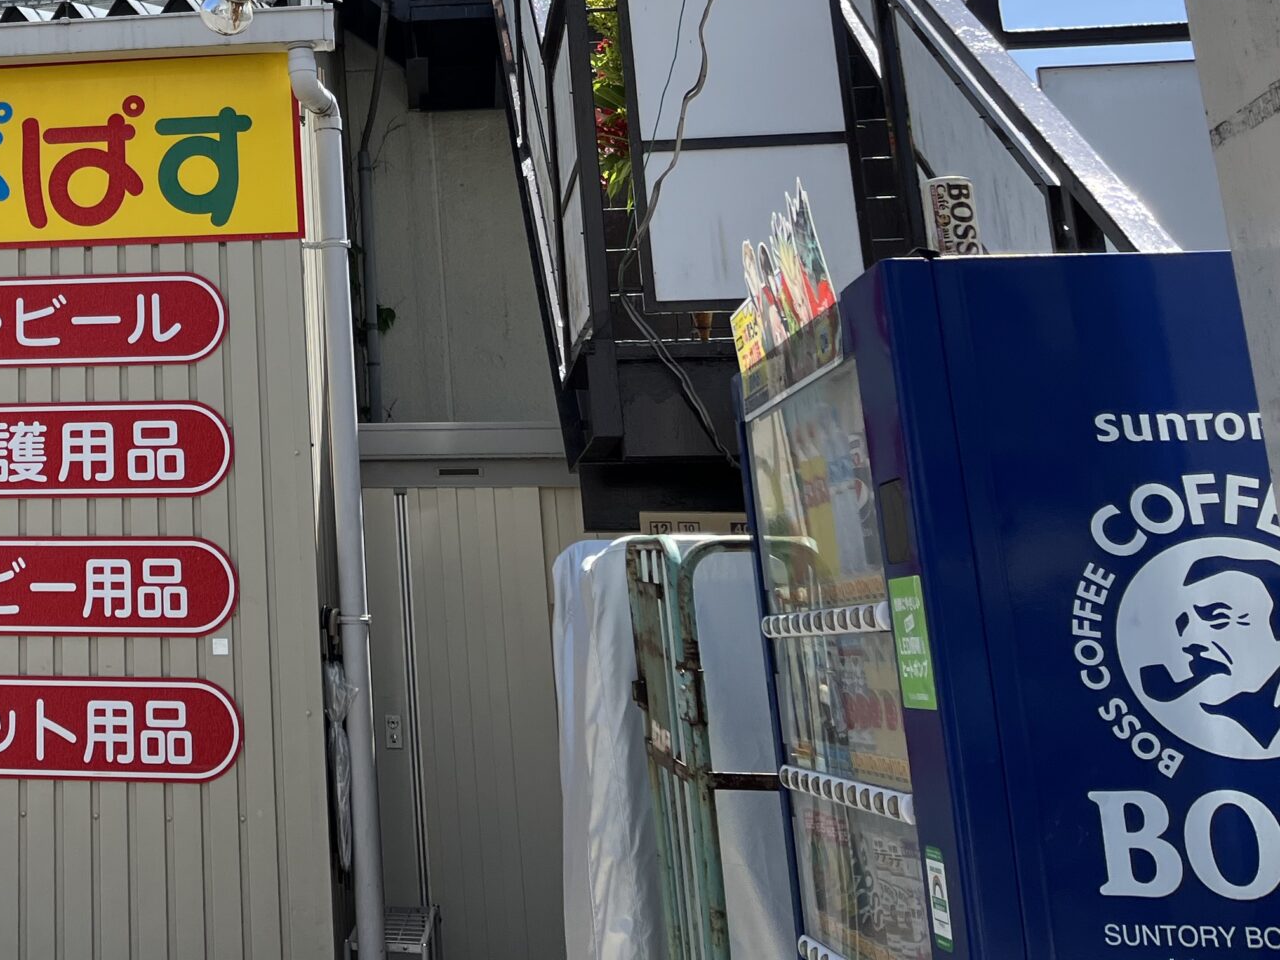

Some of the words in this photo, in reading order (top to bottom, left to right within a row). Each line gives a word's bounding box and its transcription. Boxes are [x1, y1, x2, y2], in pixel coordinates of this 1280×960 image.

[946, 182, 979, 256] BOSS
[1071, 562, 1117, 691] COFFEE
[1098, 697, 1185, 780] BOSS
[1104, 923, 1237, 948] SUNTORY
